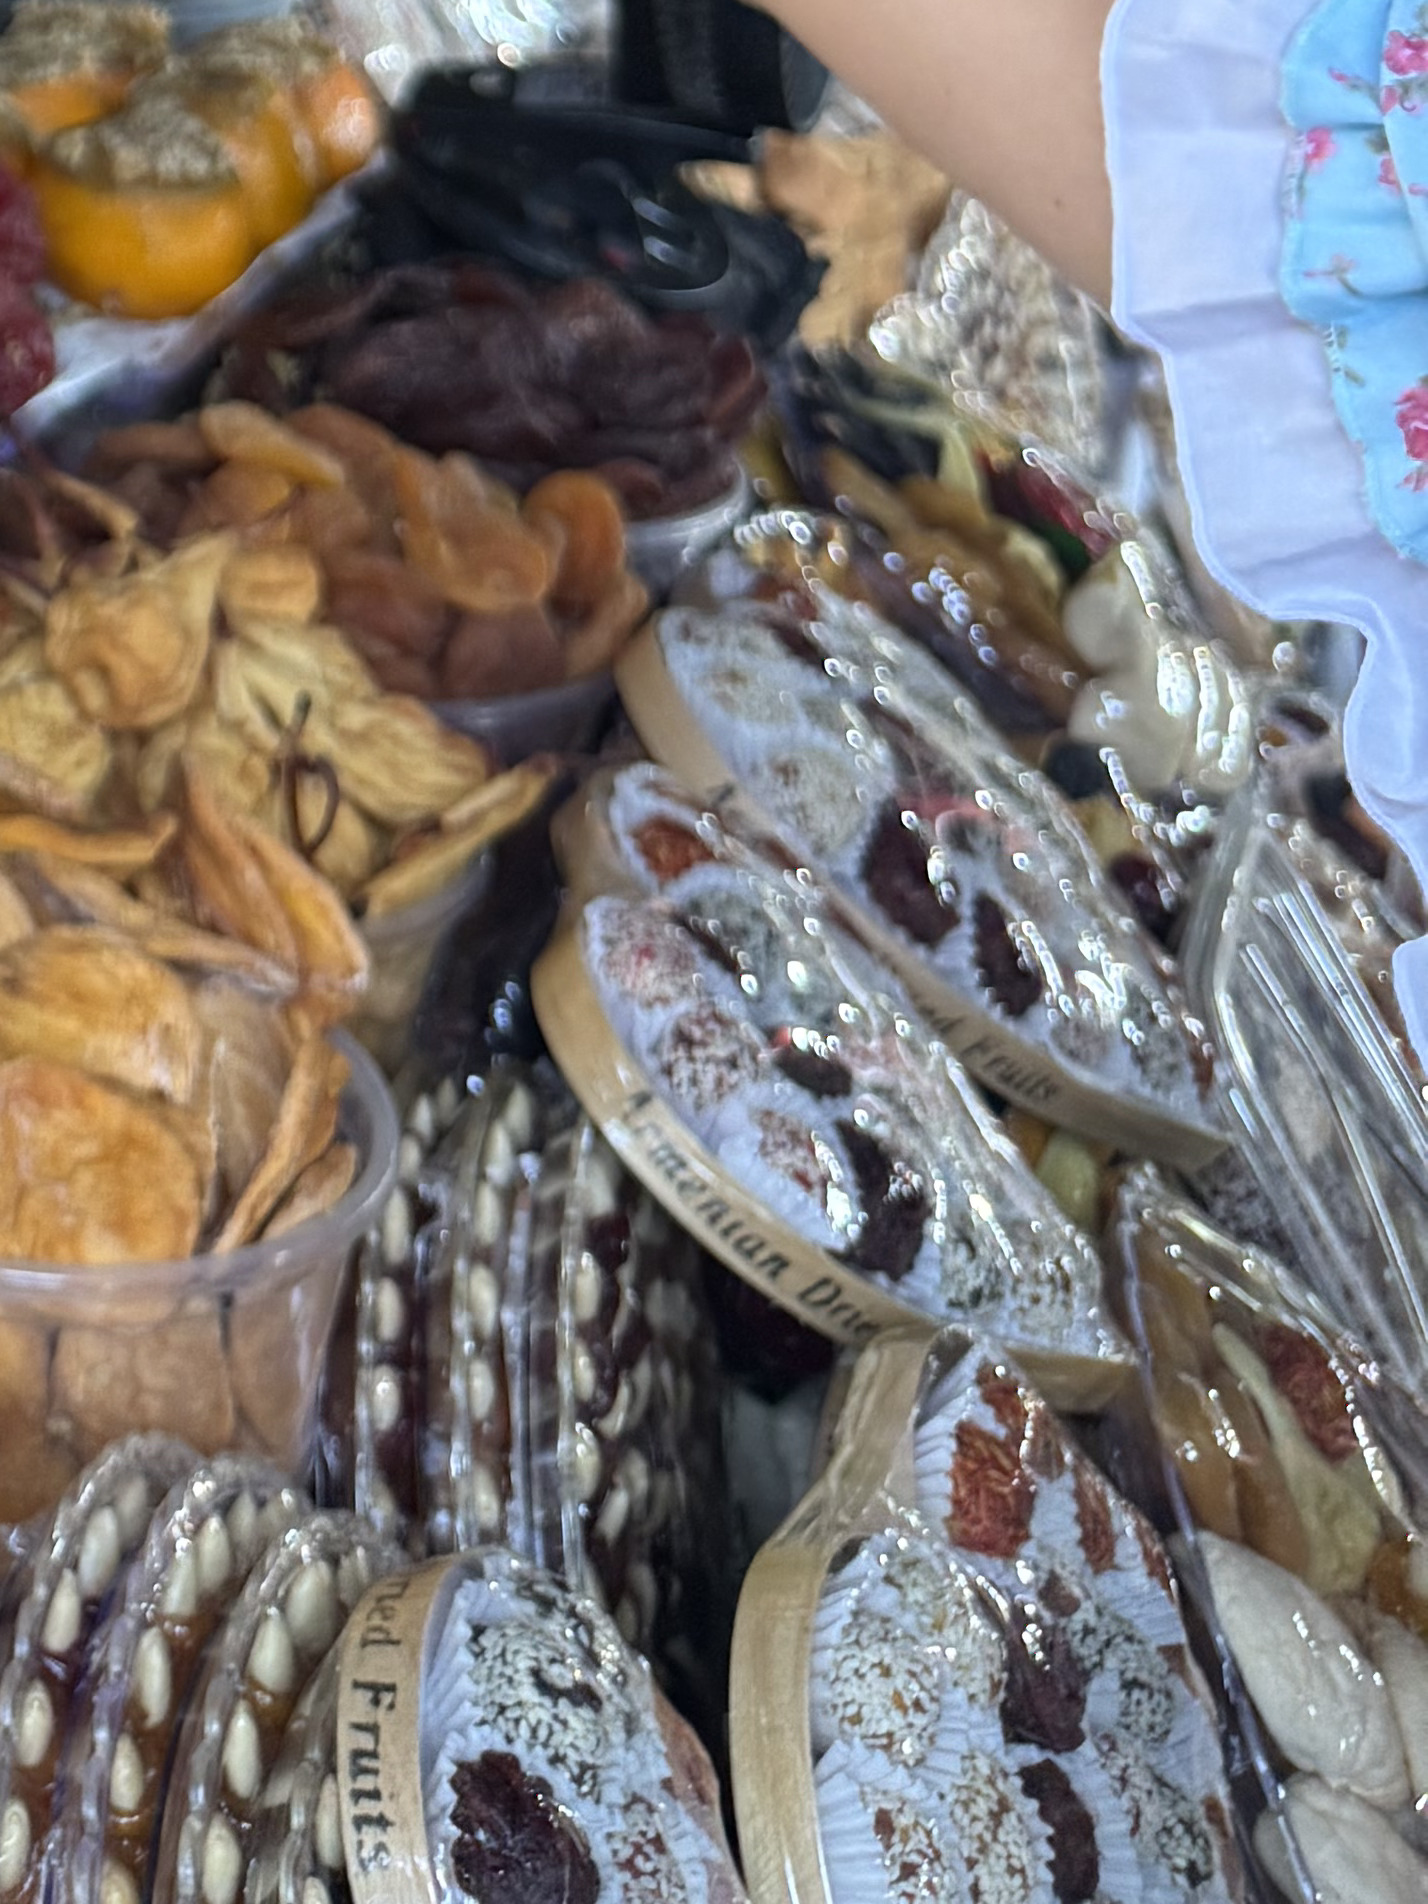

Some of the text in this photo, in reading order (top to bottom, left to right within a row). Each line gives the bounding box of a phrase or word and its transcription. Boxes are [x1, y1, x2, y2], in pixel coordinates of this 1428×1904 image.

[626, 1091, 880, 1335] Armenian Drie
[349, 1578, 410, 1873] ried Fruits
